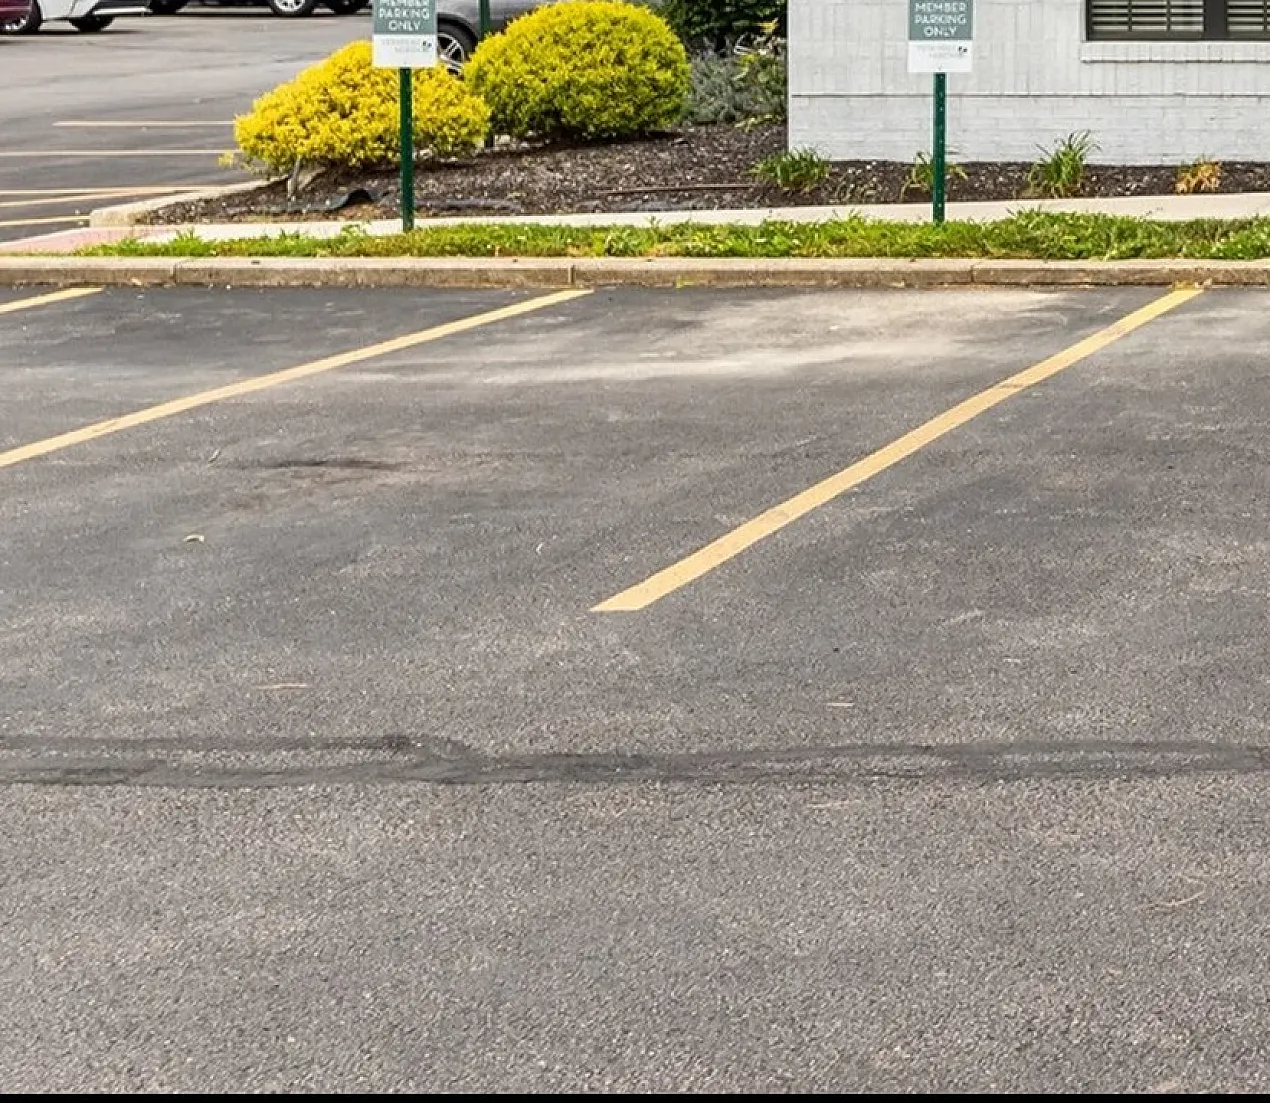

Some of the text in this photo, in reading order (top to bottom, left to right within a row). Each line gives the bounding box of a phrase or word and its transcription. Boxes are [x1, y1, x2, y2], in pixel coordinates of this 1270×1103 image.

[914, 2, 966, 13] MEMBER
[379, 9, 430, 20] PARKING
[914, 14, 967, 24] PARKING
[388, 20, 420, 31] ONLY
[923, 26, 957, 37] ONLY
